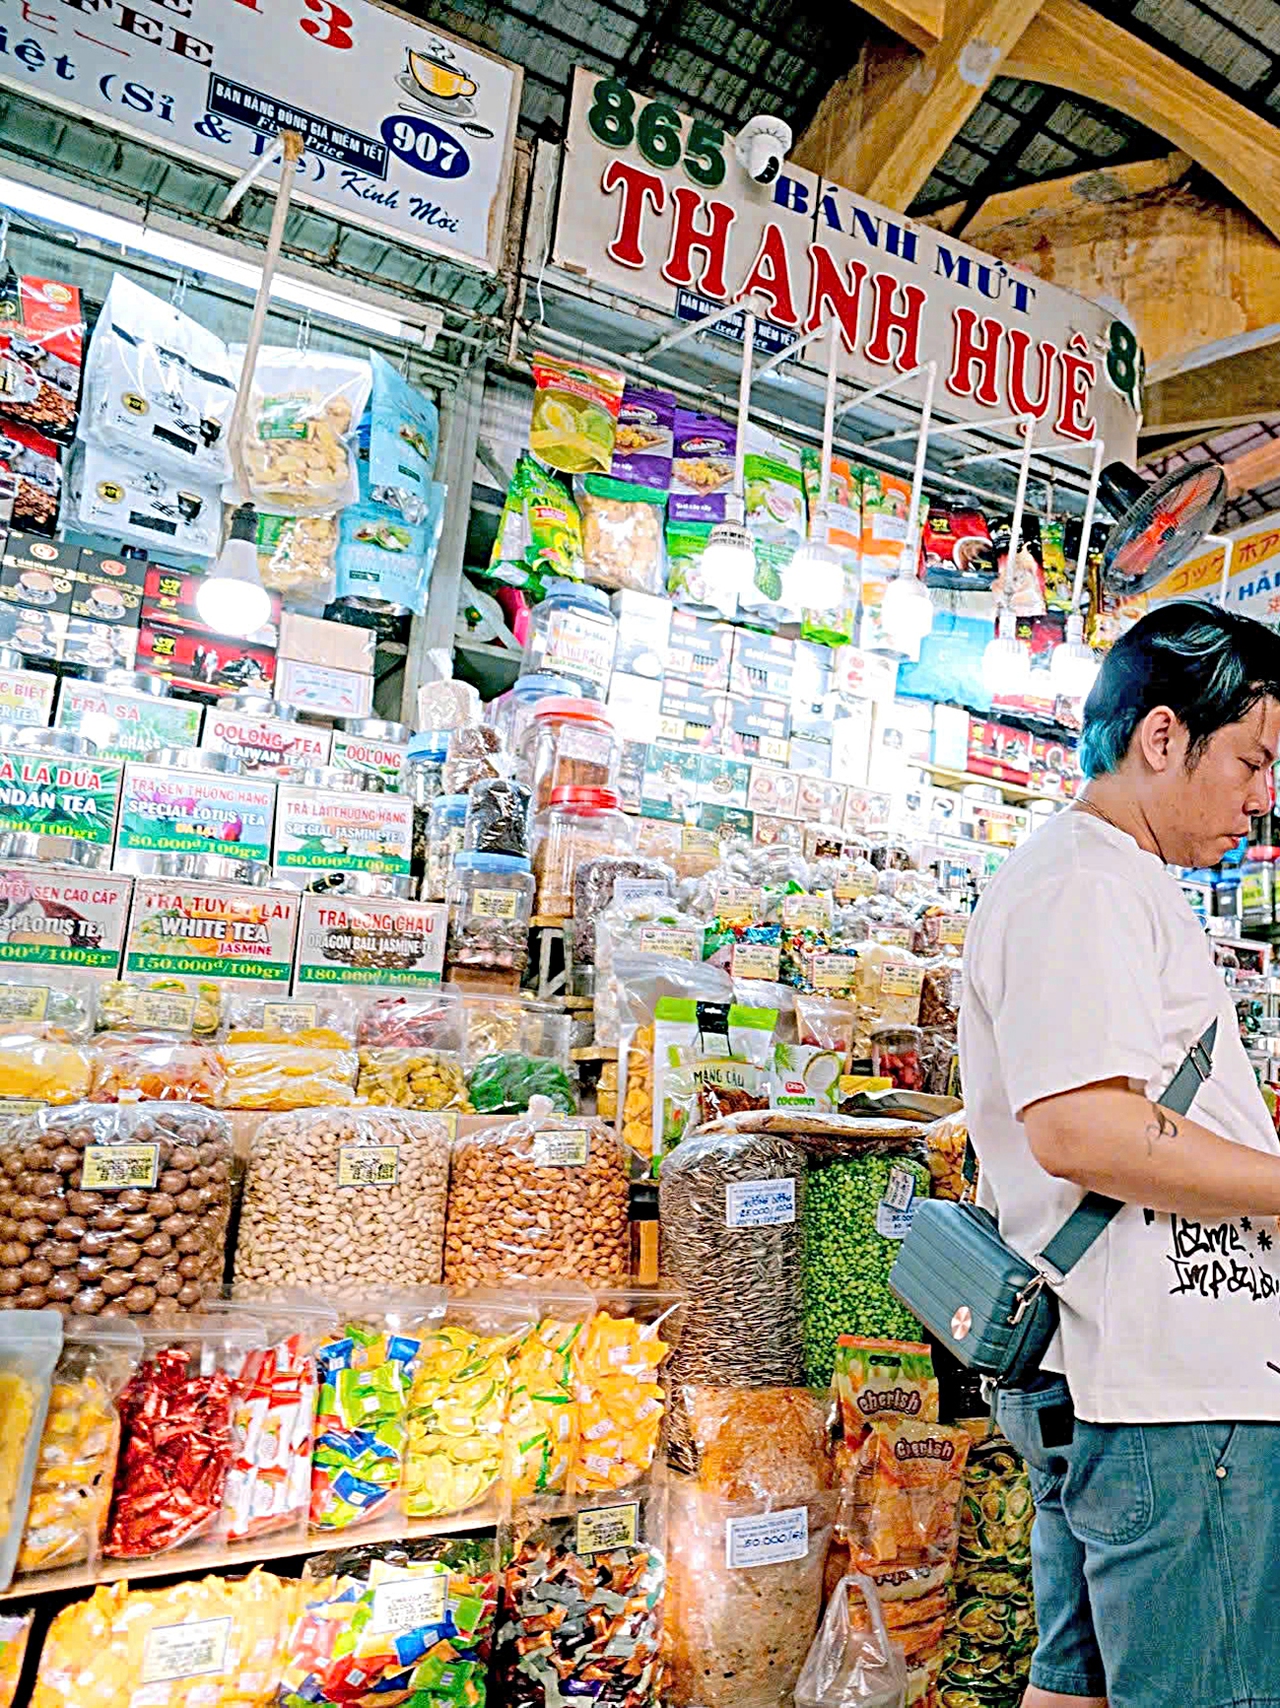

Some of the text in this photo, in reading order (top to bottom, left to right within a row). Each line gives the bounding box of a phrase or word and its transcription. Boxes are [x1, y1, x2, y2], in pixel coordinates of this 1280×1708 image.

[243, 96, 275, 119] HÀNG
[194, 113, 231, 144] &
[588, 78, 728, 188] 865
[305, 136, 345, 161] Price
[392, 121, 462, 171] 907
[341, 170, 459, 234] Kính Mời
[774, 173, 1037, 315] BÁNH MỨT
[601, 161, 928, 374] THANH
[213, 723, 322, 754] OOLONG TEA
[346, 745, 400, 768] OOLONG
[61, 794, 97, 814] TEA
[129, 801, 265, 826] SPECIAL LOTUS TEA
[34, 886, 59, 901] SEN
[64, 888, 88, 902] CAO
[262, 901, 291, 920] LÀI
[23, 916, 75, 936] LOTUS
[79, 920, 107, 938] TEA
[160, 916, 270, 943] WHITE TEA
[218, 943, 273, 957] JASMINE
[353, 936, 377, 951] BALL
[379, 937, 421, 956] JASMINE
